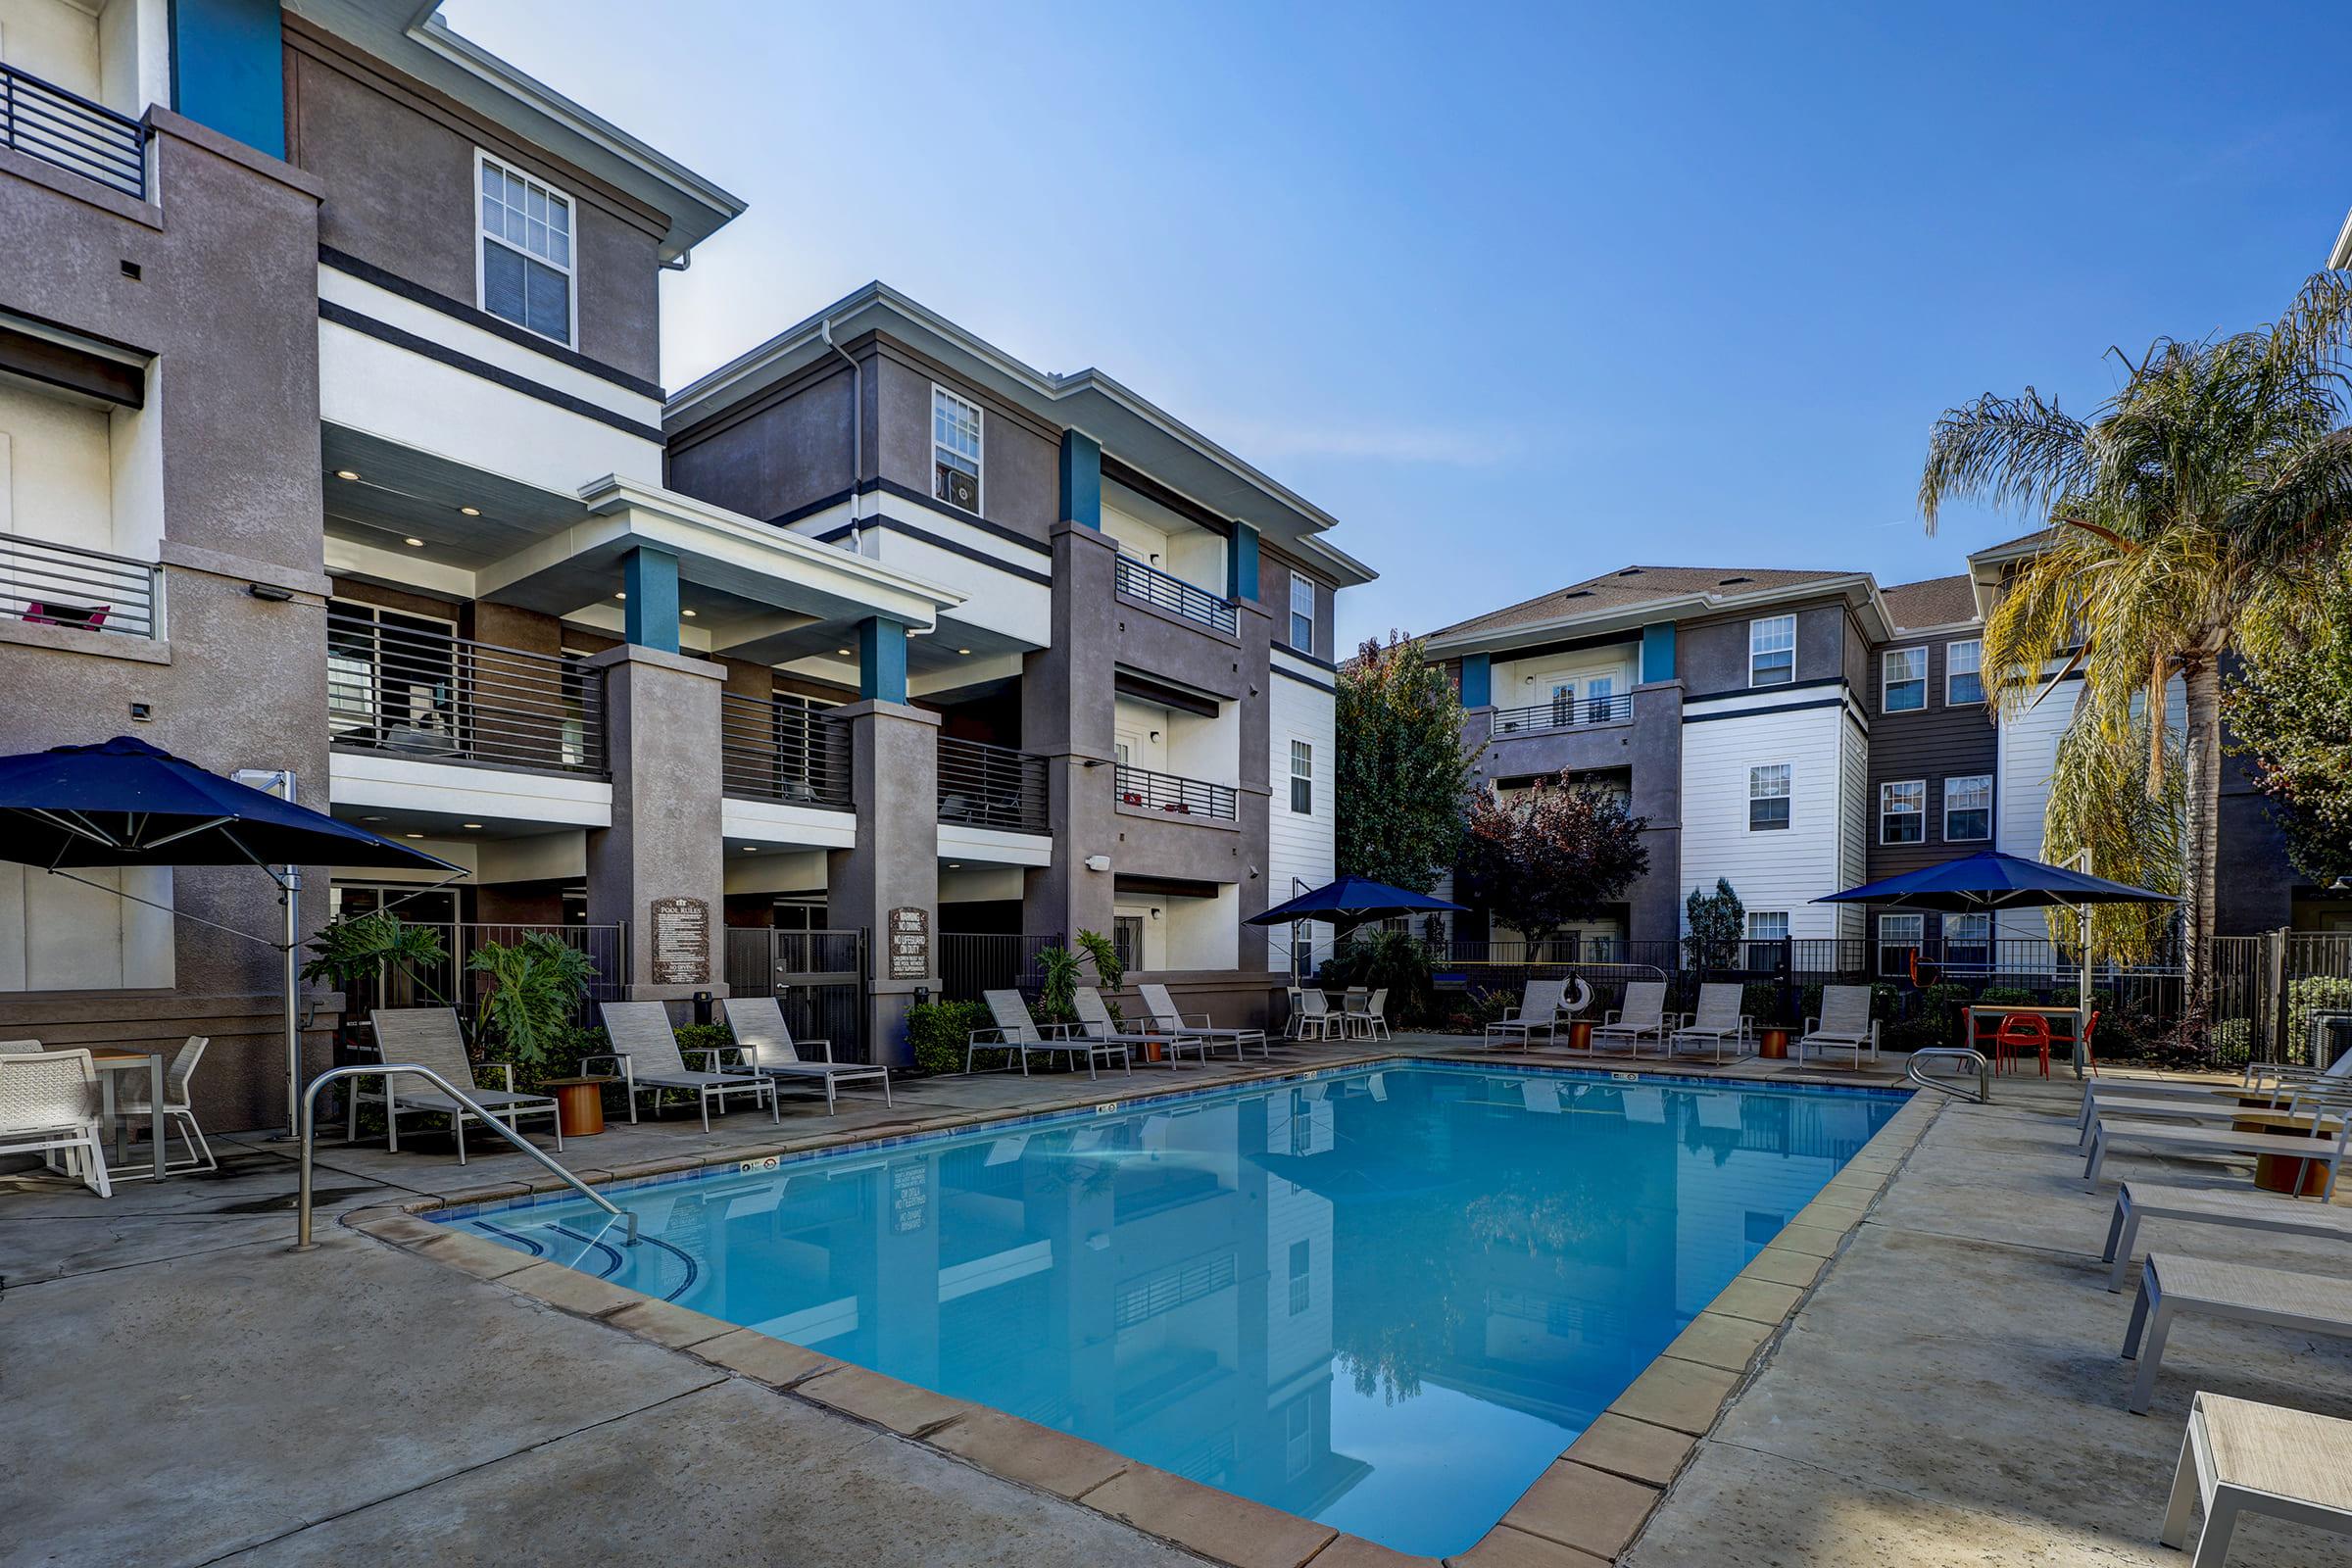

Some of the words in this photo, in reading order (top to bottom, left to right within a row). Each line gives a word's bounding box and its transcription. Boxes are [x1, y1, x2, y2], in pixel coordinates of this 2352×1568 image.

[900, 911, 920, 921] WARNING
[899, 921, 906, 931] NO
[906, 921, 921, 931] DIVING
[894, 935, 902, 945] NO
[902, 935, 925, 945] LIFEGUARD
[901, 945, 907, 954] ON
[908, 945, 920, 955] DUTY
